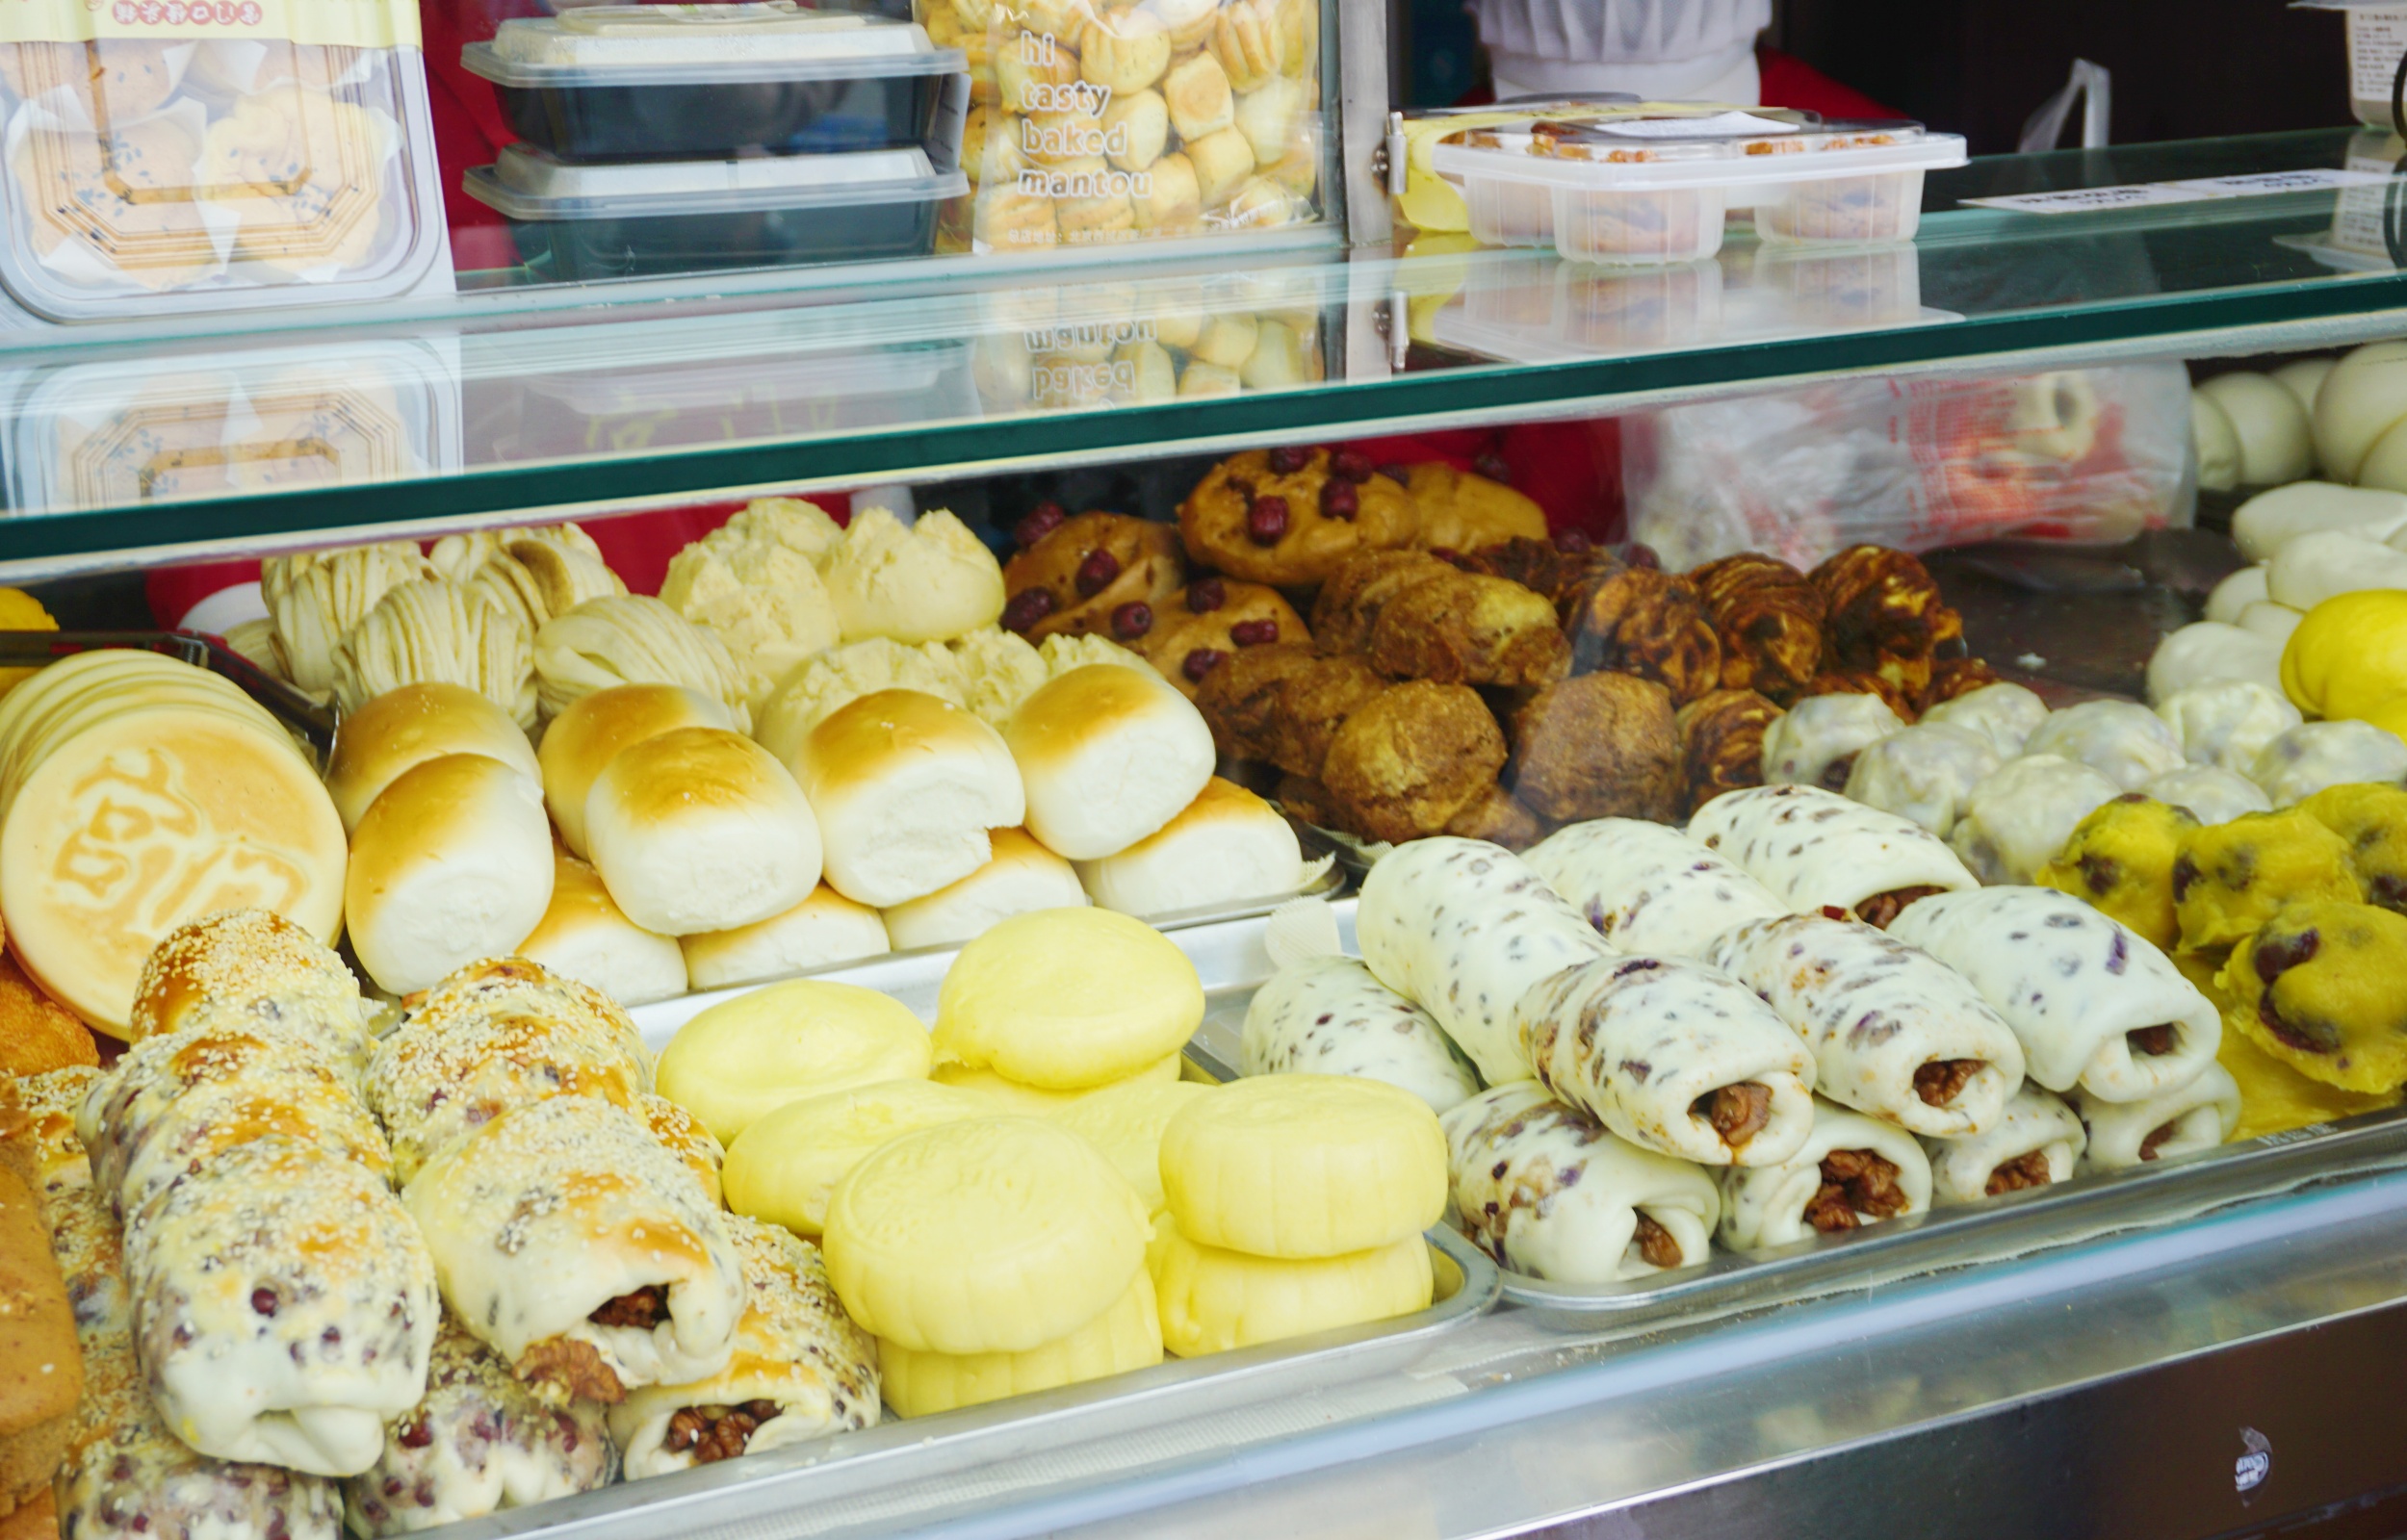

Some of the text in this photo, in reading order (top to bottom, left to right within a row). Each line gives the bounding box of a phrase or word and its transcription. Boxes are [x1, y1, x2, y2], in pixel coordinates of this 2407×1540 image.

[1021, 30, 1055, 66] hi
[1021, 80, 1111, 118] tasty
[1022, 118, 1127, 156] baked
[1018, 168, 1152, 198] mantou
